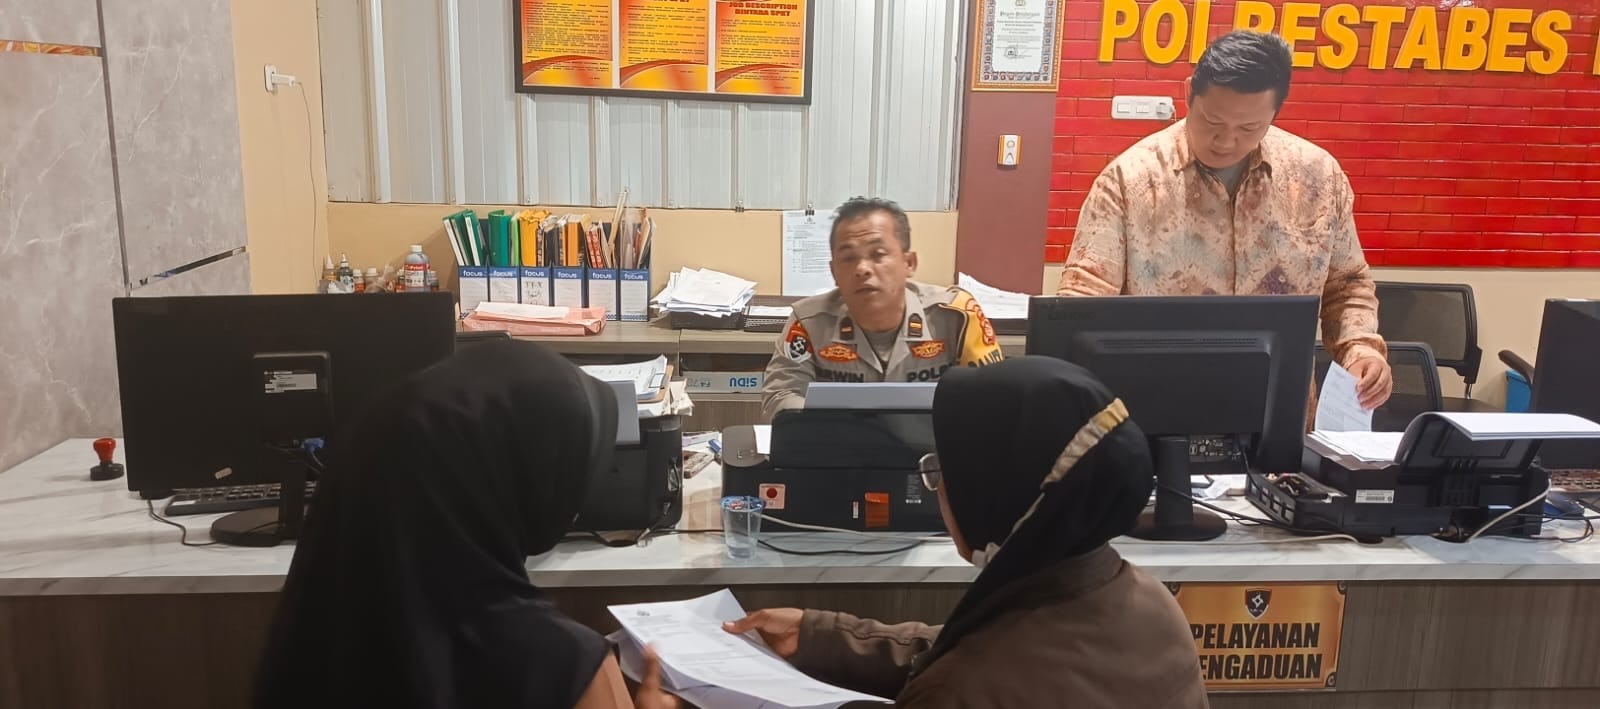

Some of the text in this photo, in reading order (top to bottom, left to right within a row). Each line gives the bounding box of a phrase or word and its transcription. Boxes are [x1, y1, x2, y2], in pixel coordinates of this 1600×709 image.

[745, 2, 798, 10] DESCRIPTION
[558, 271, 577, 279] focus
[592, 272, 612, 280] focus
[1190, 622, 1320, 649] PELAYANAN
[1199, 653, 1323, 680] ENGADUAN
